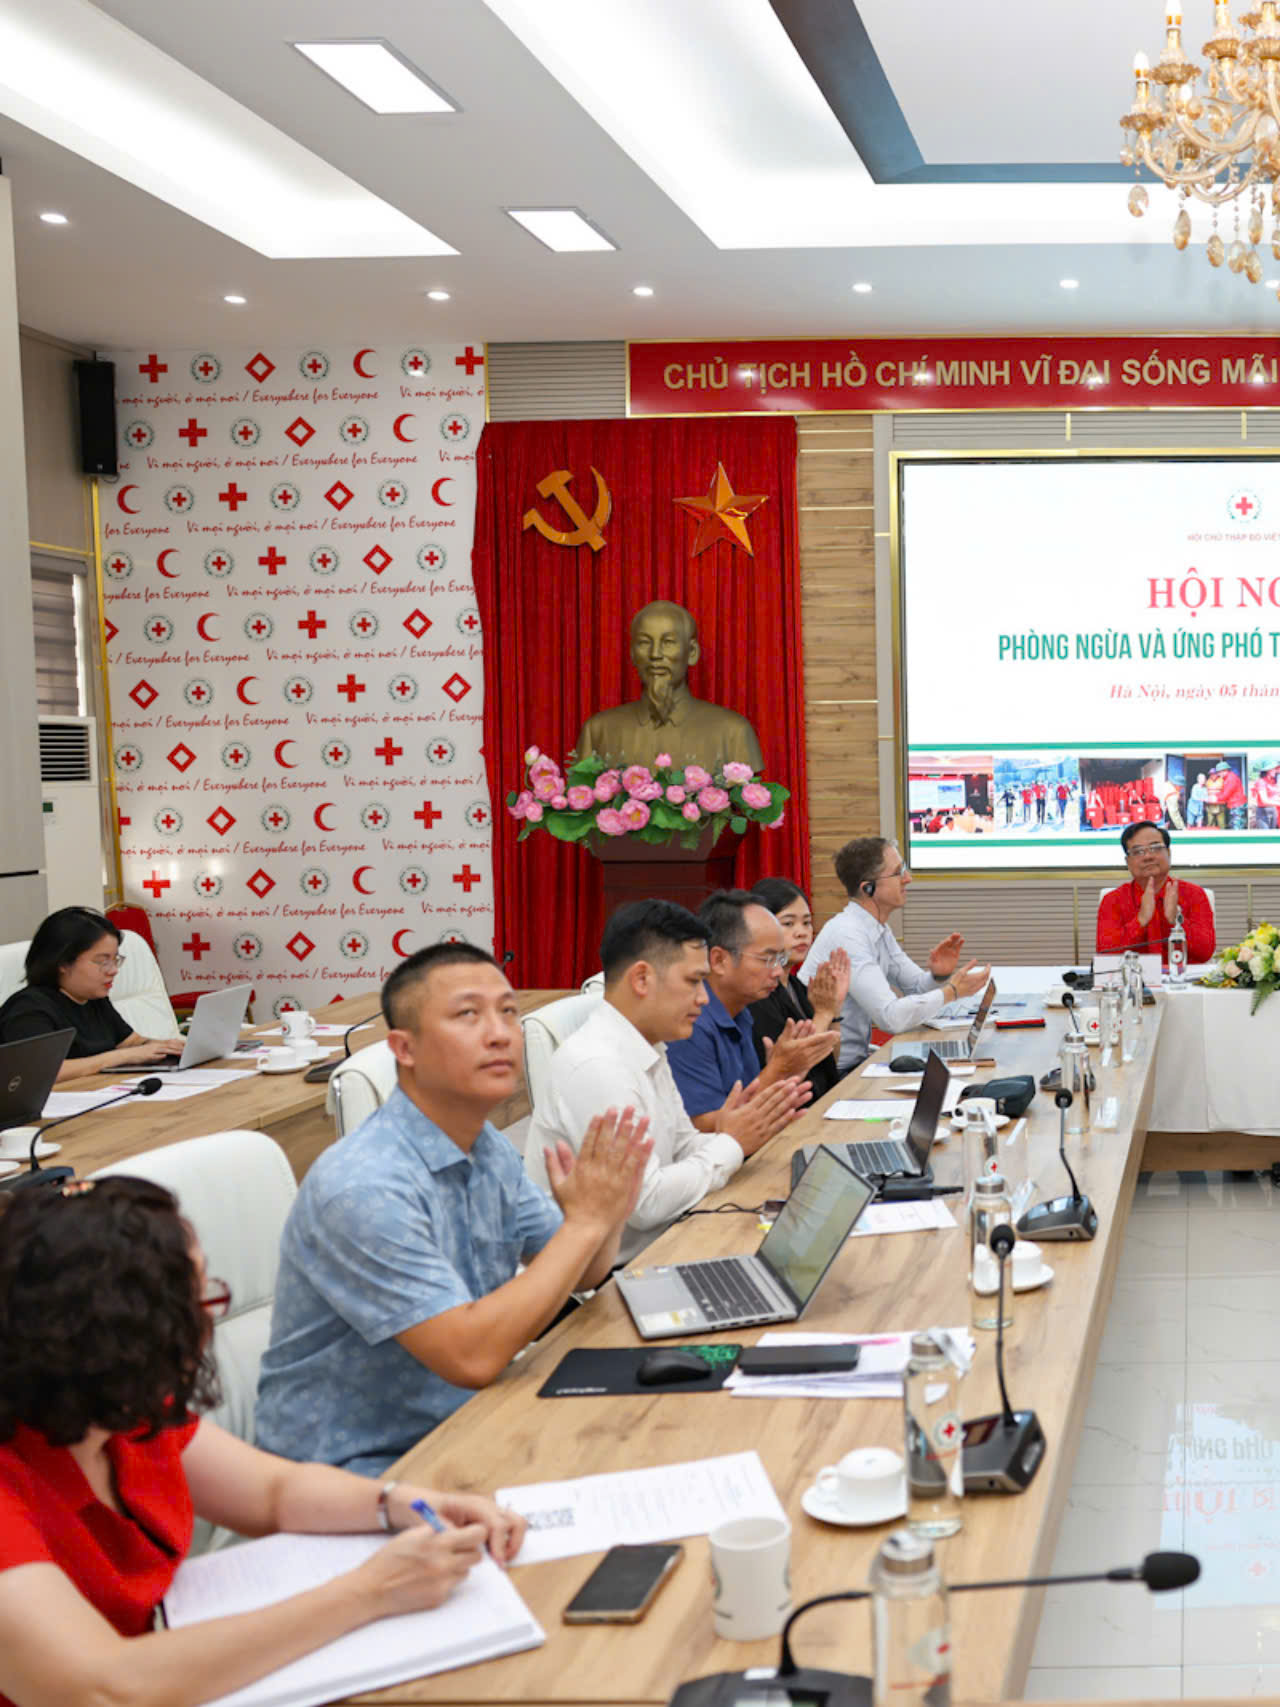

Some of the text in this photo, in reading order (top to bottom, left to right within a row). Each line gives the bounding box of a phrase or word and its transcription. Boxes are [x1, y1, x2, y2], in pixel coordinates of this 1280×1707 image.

[664, 356, 728, 390] CHỦ
[737, 361, 810, 394] TỊCH
[821, 350, 867, 388] HỒ
[875, 354, 930, 386] CHÍ
[935, 360, 1011, 386] MINH
[1020, 354, 1051, 385] VĨ
[1057, 360, 1111, 392] ĐẠI
[1121, 349, 1210, 385] SỐNG
[1222, 354, 1278, 384] MÃI
[252, 389, 308, 406] Everywhere
[312, 388, 328, 405] for
[332, 387, 378, 404] Everyone
[292, 453, 348, 470] Everywhere
[351, 452, 367, 469] for
[371, 451, 417, 468] Everyone
[104, 522, 170, 540] for Everyone
[331, 517, 387, 534] Everywhere
[389, 516, 405, 533] for
[409, 515, 455, 532] Everyone
[144, 586, 210, 604] for Everyone
[370, 581, 426, 598] Everywhere
[429, 580, 445, 597] for
[1146, 566, 1224, 618] HỘI
[998, 628, 1069, 661] PHÒNG
[1076, 627, 1132, 660] NGỪA
[1137, 627, 1167, 659] VÀ
[1173, 627, 1215, 659] ỨNG
[1222, 626, 1263, 658] PHÓ
[1109, 684, 1132, 699] Hà
[1137, 684, 1171, 702] Nội,
[1175, 684, 1214, 701] ngày
[1218, 683, 1238, 697] 05
[165, 713, 289, 732] Everywhere for Everyone
[281, 902, 405, 921] Everywhere for Everyone
